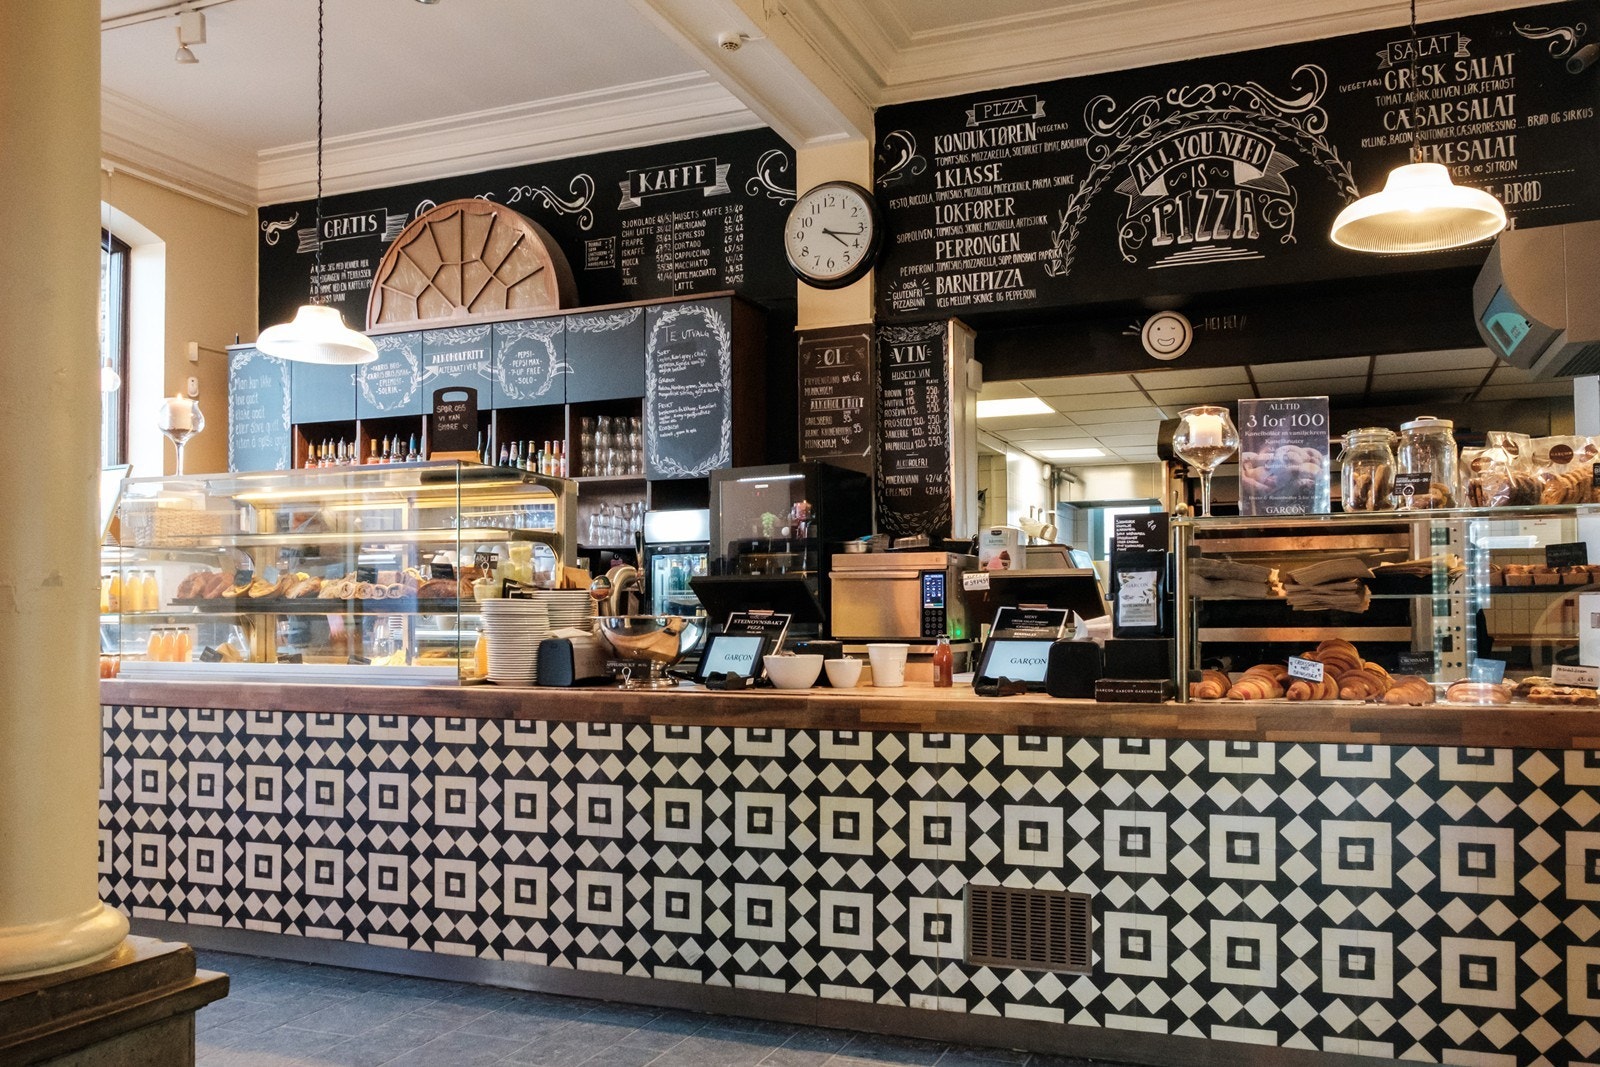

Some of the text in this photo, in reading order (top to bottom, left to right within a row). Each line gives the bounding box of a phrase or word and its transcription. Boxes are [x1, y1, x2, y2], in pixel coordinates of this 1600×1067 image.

[1454, 53, 1515, 82] SALAT
[984, 100, 1028, 118] PIZZA
[1527, 107, 1594, 127] BRØD OG SIRKUS
[934, 122, 1037, 154] KONDUKTØREN
[1136, 130, 1267, 187] ALL YOU NEED
[1485, 159, 1518, 174] SITRON
[639, 164, 708, 194] KAFFE
[1032, 177, 1052, 189] PARMA
[1053, 174, 1075, 187] SKINKE
[1191, 163, 1208, 188] IS
[1503, 180, 1542, 204] BRØD
[823, 196, 836, 208] 12
[674, 210, 700, 221] HUSETS
[702, 206, 722, 217] KAFFE
[811, 203, 820, 215] 11
[850, 206, 858, 218] 2
[935, 197, 1016, 225] LOKFØRER
[621, 216, 656, 229] SJOKOLADE
[801, 216, 813, 228] 10
[1152, 188, 1260, 247] PIZZA
[323, 214, 378, 239] GRATIS
[636, 226, 654, 236] LATTE
[674, 219, 707, 231] AMERICANO
[858, 222, 864, 234] 3
[674, 229, 705, 241] ESPRESSO
[796, 231, 805, 243] 9
[674, 240, 702, 251] CORTADO
[852, 237, 860, 249] 4
[935, 232, 1020, 260] PERRONGEN
[674, 248, 711, 260] CAPPUCCINO
[801, 245, 810, 257] 8
[842, 250, 850, 262] 5
[621, 257, 639, 267] MOCCA
[674, 258, 709, 270] MACCHIATO
[814, 255, 820, 267] 7
[826, 256, 835, 269] 6
[622, 267, 630, 276] TE
[674, 271, 688, 281] LATTE
[674, 280, 694, 292] LATTE
[936, 268, 1025, 296] BARNEPIZZA
[892, 288, 923, 301] GLUTENFRI
[936, 288, 1037, 308] VELG MELLOM SKINKE OG PEPPERONI
[892, 298, 926, 310] PIZZABUNN
[661, 324, 710, 344] TE UTVALG
[824, 348, 846, 366] ØL
[893, 344, 928, 363] VIN
[438, 362, 477, 374] ALTERNATIVER
[891, 368, 931, 380] HUSETS VIN
[1268, 403, 1300, 411] ALLTID
[884, 418, 912, 428] PROSECCO
[1246, 413, 1325, 428] 3 for 100
[885, 474, 919, 485] MINERALVANN
[1266, 506, 1306, 515] GARÇON
[724, 653, 753, 662] GARÇON
[1010, 656, 1047, 666] GARÇON
